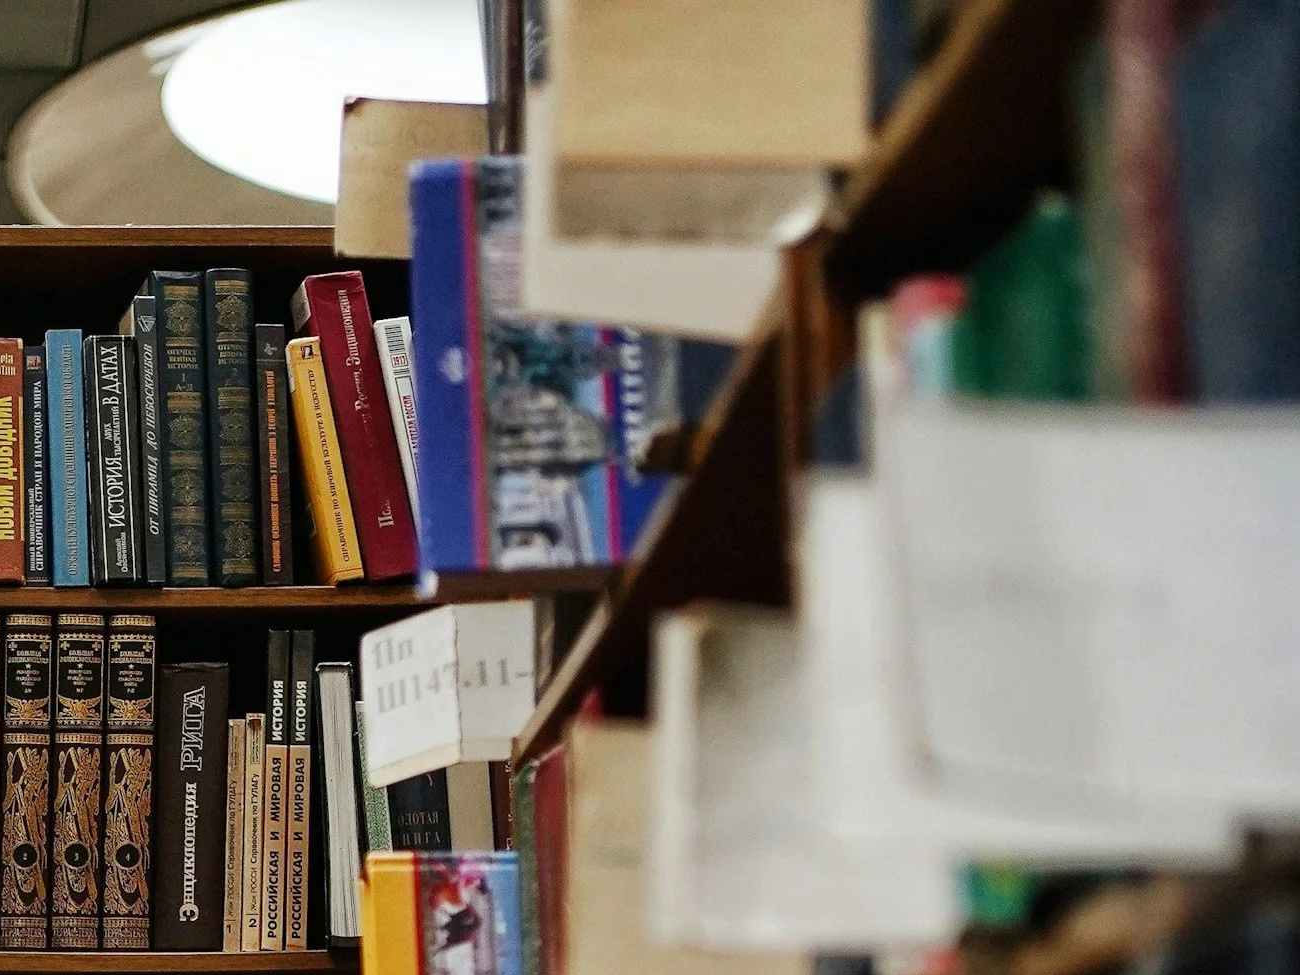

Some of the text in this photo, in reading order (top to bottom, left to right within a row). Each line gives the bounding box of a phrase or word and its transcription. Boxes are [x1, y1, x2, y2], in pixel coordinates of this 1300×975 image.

[33, 380, 42, 409] МИРА
[100, 345, 122, 405] В ДАТАХ
[402, 394, 414, 420] РОССИИ
[33, 411, 43, 458] НАРОДОВ
[144, 343, 159, 535] ОТ ПИРАМИД ДО НЕБОСКРЕБОВ
[316, 420, 331, 458] КУЛЬТУРЕ
[34, 470, 44, 502] СТРАН
[104, 456, 126, 528] ИСТОРИЯ
[324, 459, 338, 497] МИРОВОЙ
[332, 498, 340, 510] ПО
[34, 504, 44, 572] СПРАВОЧНИК
[333, 511, 349, 562] СПРАВОЧНИК
[179, 686, 206, 922] Энциклопедия РИГА
[252, 773, 260, 805] ГУЛАГу
[252, 805, 259, 815] по
[265, 680, 285, 939] РОССИЙСКАЯ И МИРОВАЯ ИСТОРИЯ
[290, 680, 309, 939] РОССИЙСКАЯ И МИРОВАЯ ИСТОРИЯ
[228, 821, 237, 870] Справочник
[250, 816, 259, 864] Справочник
[250, 867, 258, 894] РОССИ
[225, 923, 232, 933] 1
[248, 918, 257, 928] 2
